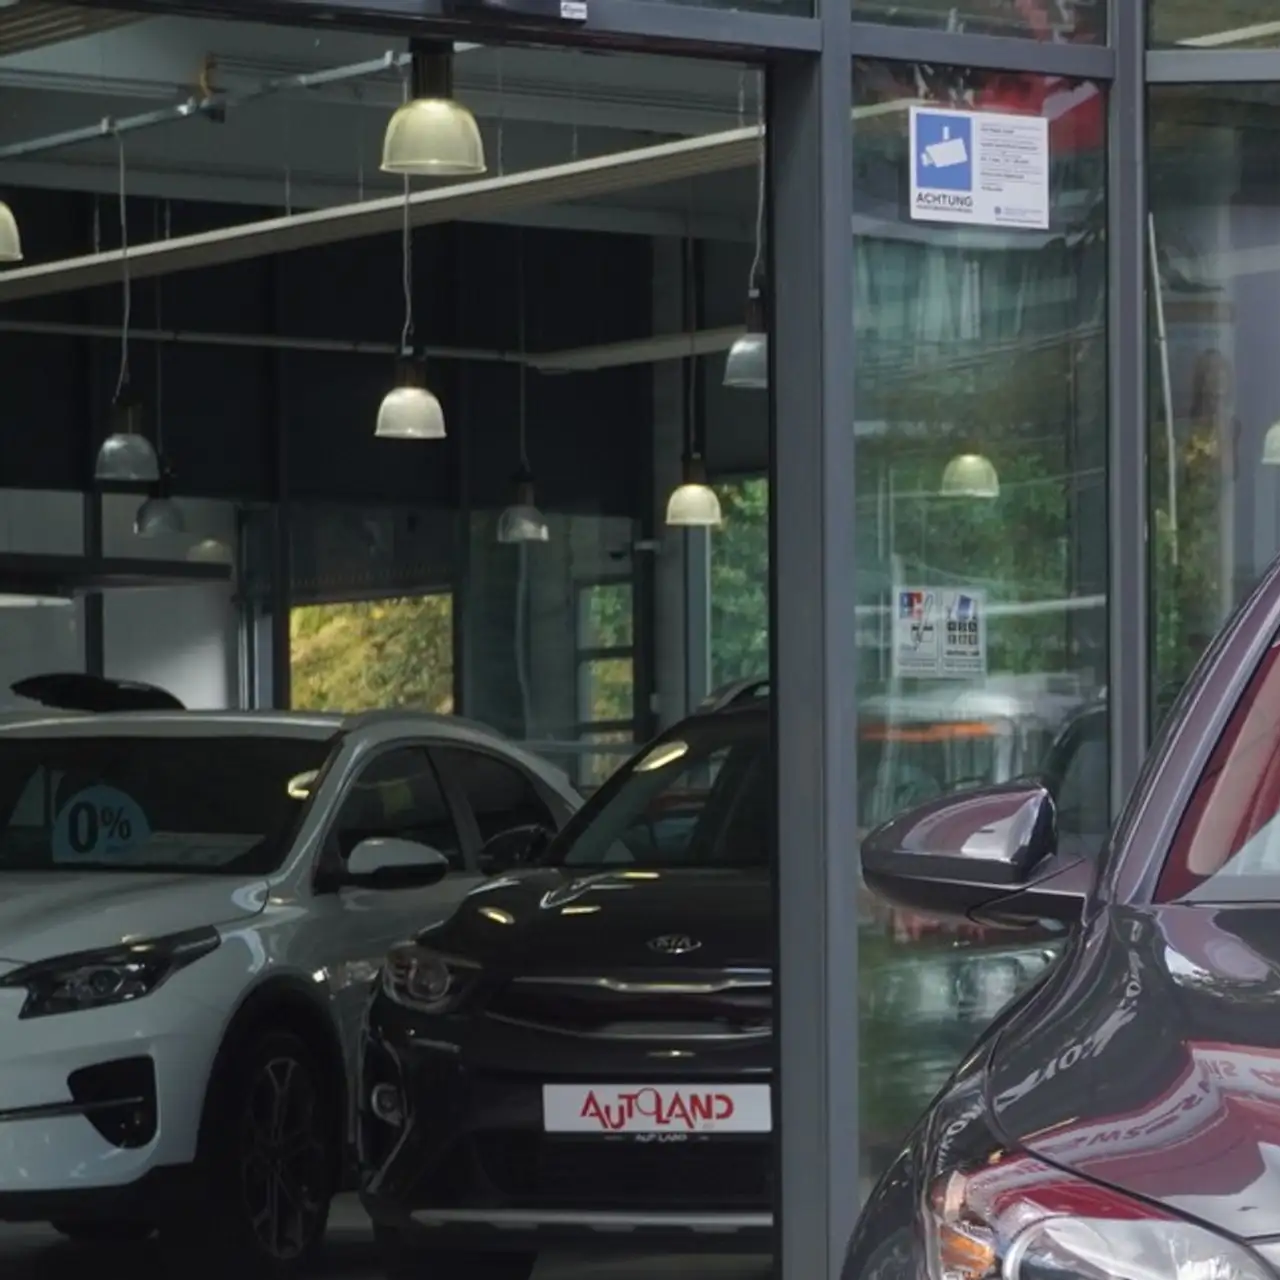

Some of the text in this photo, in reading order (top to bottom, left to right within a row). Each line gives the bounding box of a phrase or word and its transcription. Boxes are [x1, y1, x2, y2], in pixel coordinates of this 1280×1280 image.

[916, 192, 973, 208] ACHTUNG
[68, 801, 132, 853] 0%
[580, 1087, 734, 1129] AUTOLAND
